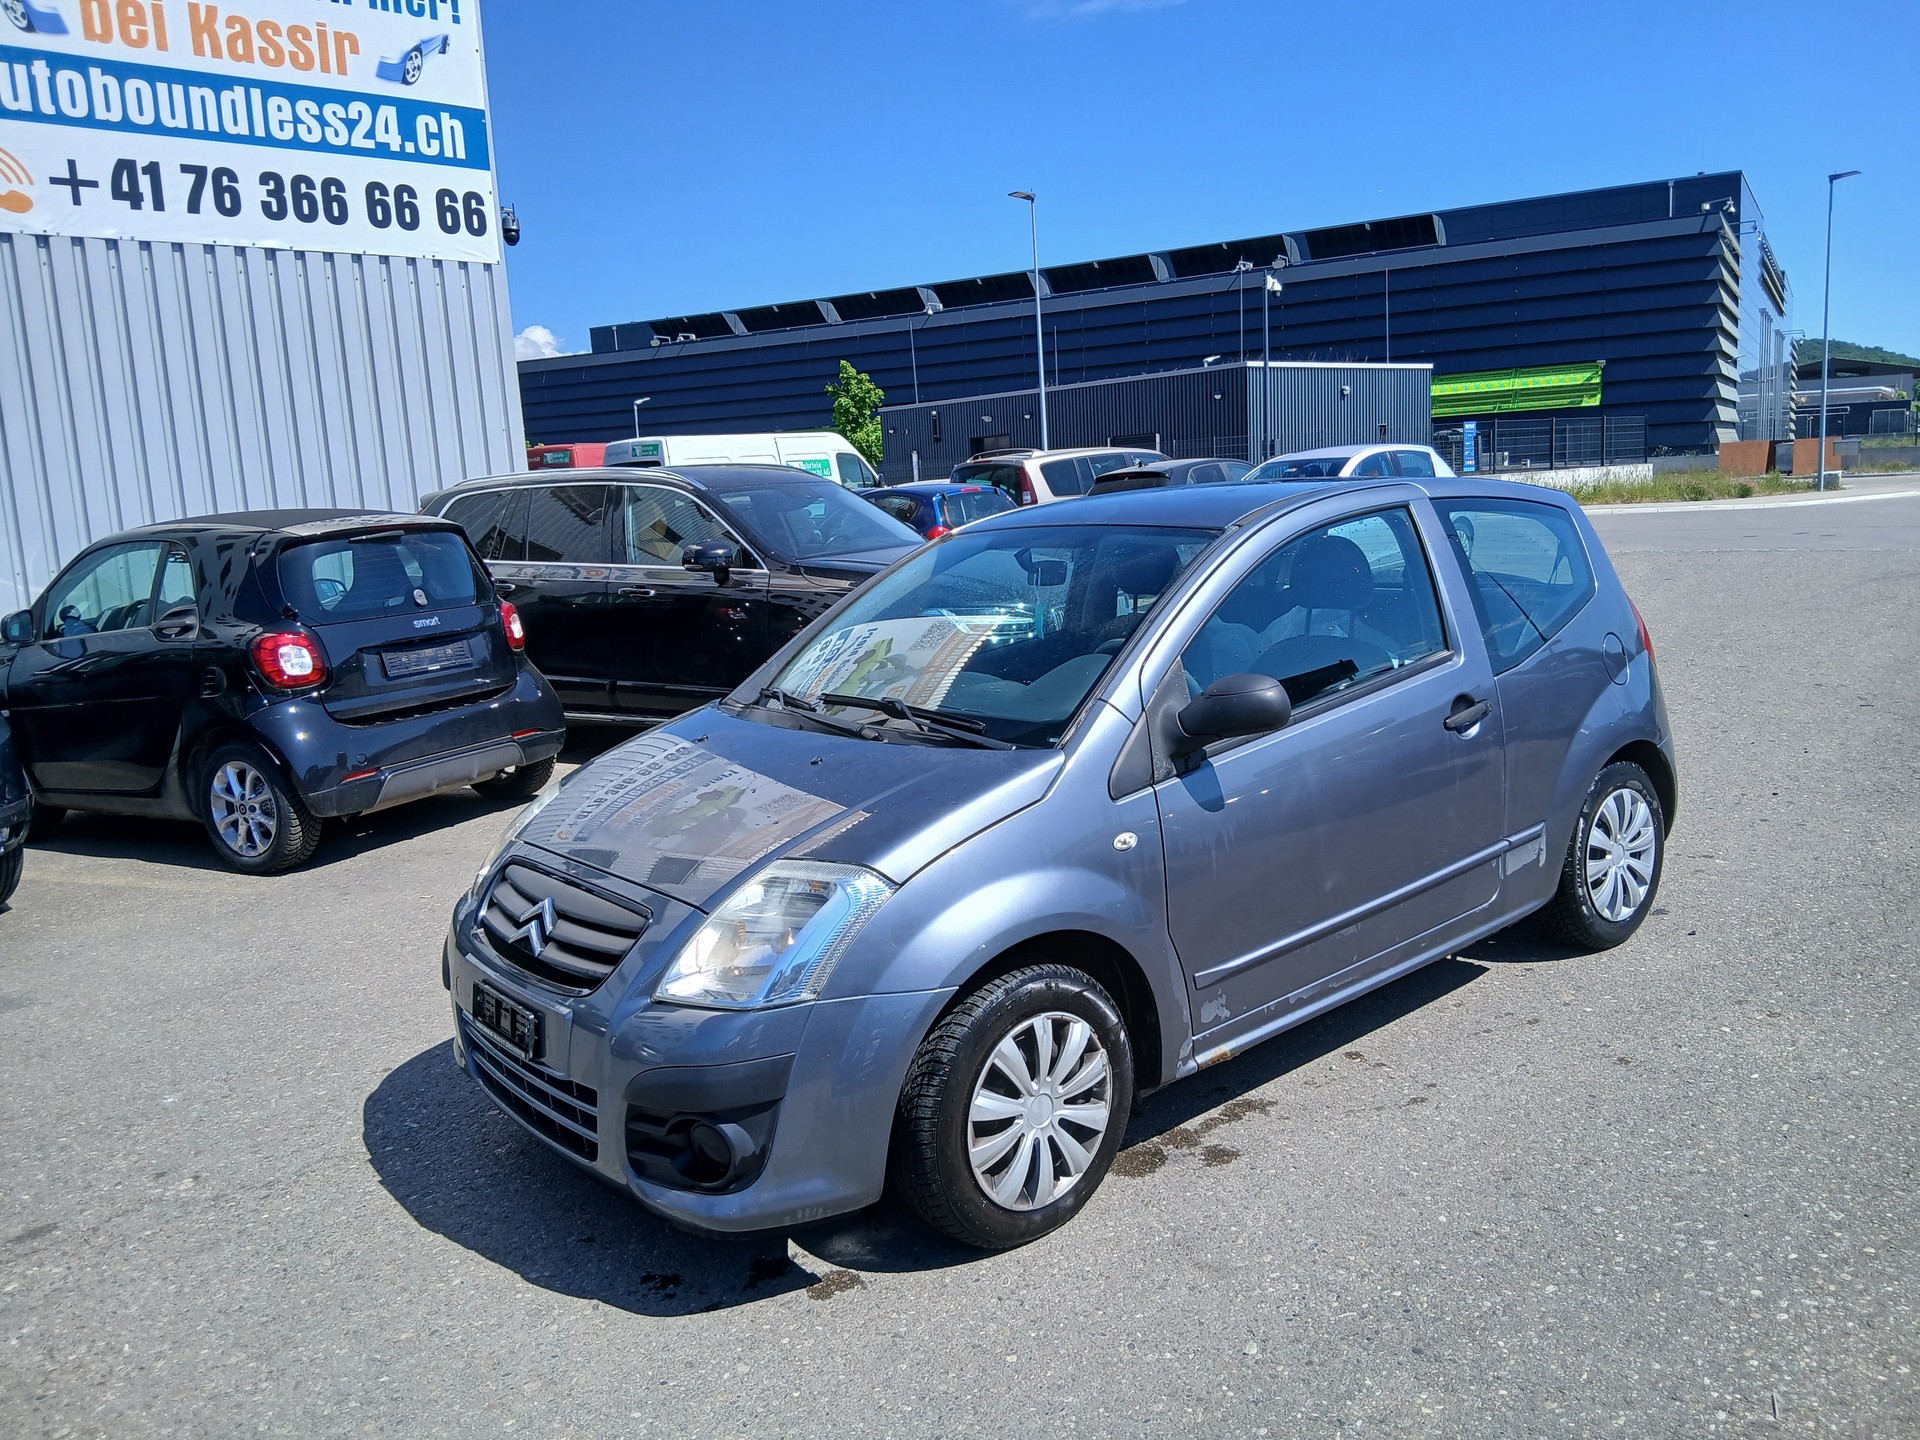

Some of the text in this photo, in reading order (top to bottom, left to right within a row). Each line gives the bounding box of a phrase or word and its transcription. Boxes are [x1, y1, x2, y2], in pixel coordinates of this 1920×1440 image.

[80, 0, 360, 76] bei Kassir
[180, 163, 242, 218] 76
[259, 171, 349, 226] 366
[365, 181, 420, 231] 66
[435, 188, 488, 237] 66
[413, 616, 441, 628] smart
